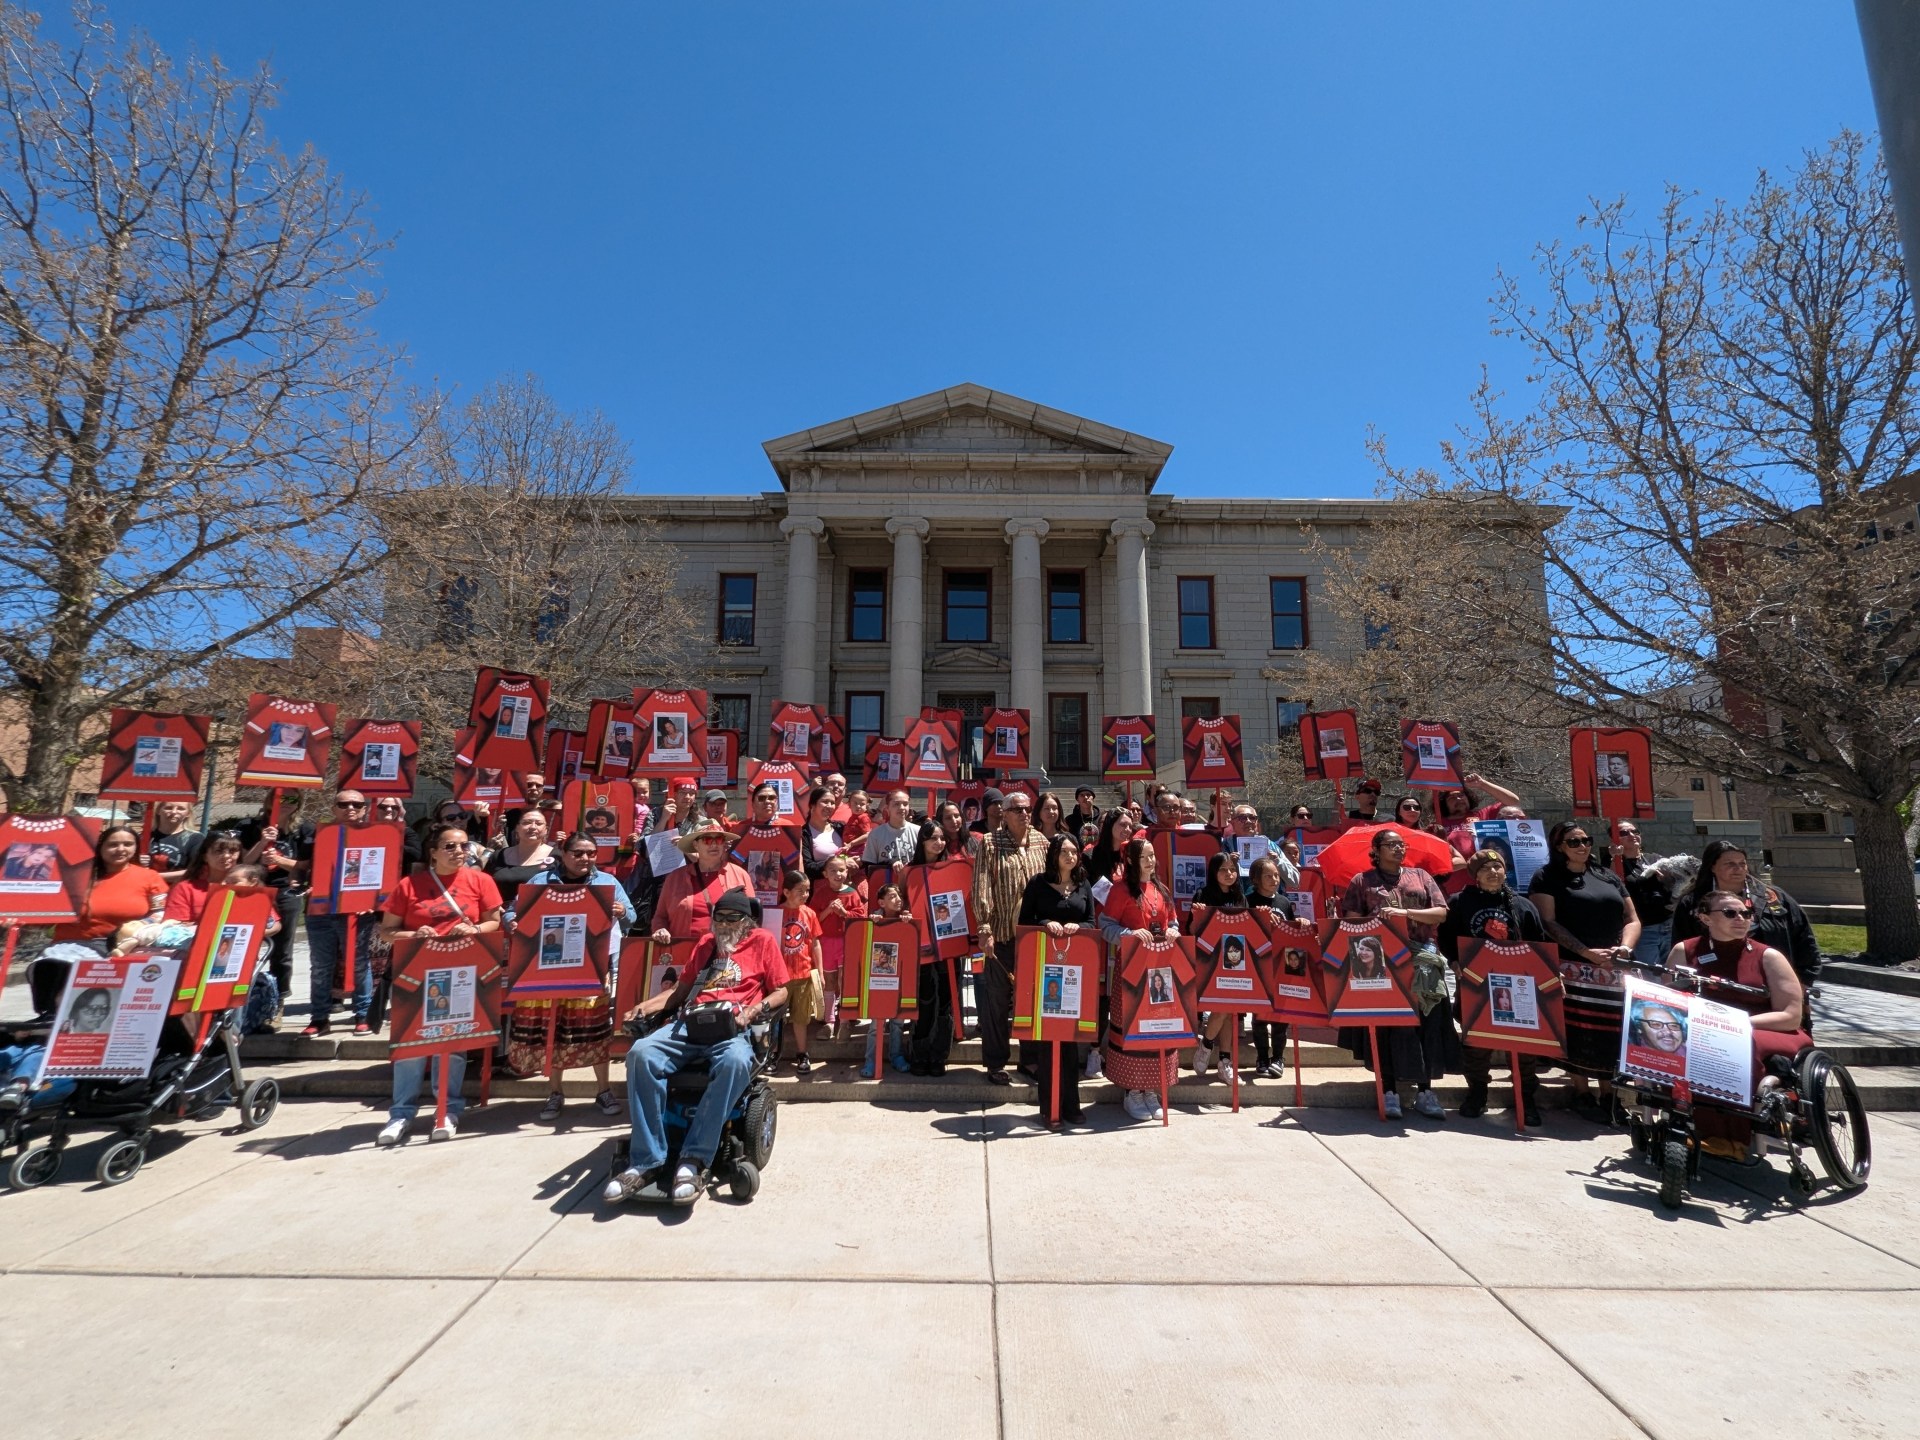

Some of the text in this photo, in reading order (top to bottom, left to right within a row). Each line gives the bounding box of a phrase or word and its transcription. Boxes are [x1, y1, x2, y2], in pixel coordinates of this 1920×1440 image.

[912, 475, 1022, 491] CITY HALL
[1691, 1016, 1744, 1035] JOSEPH HOULE
